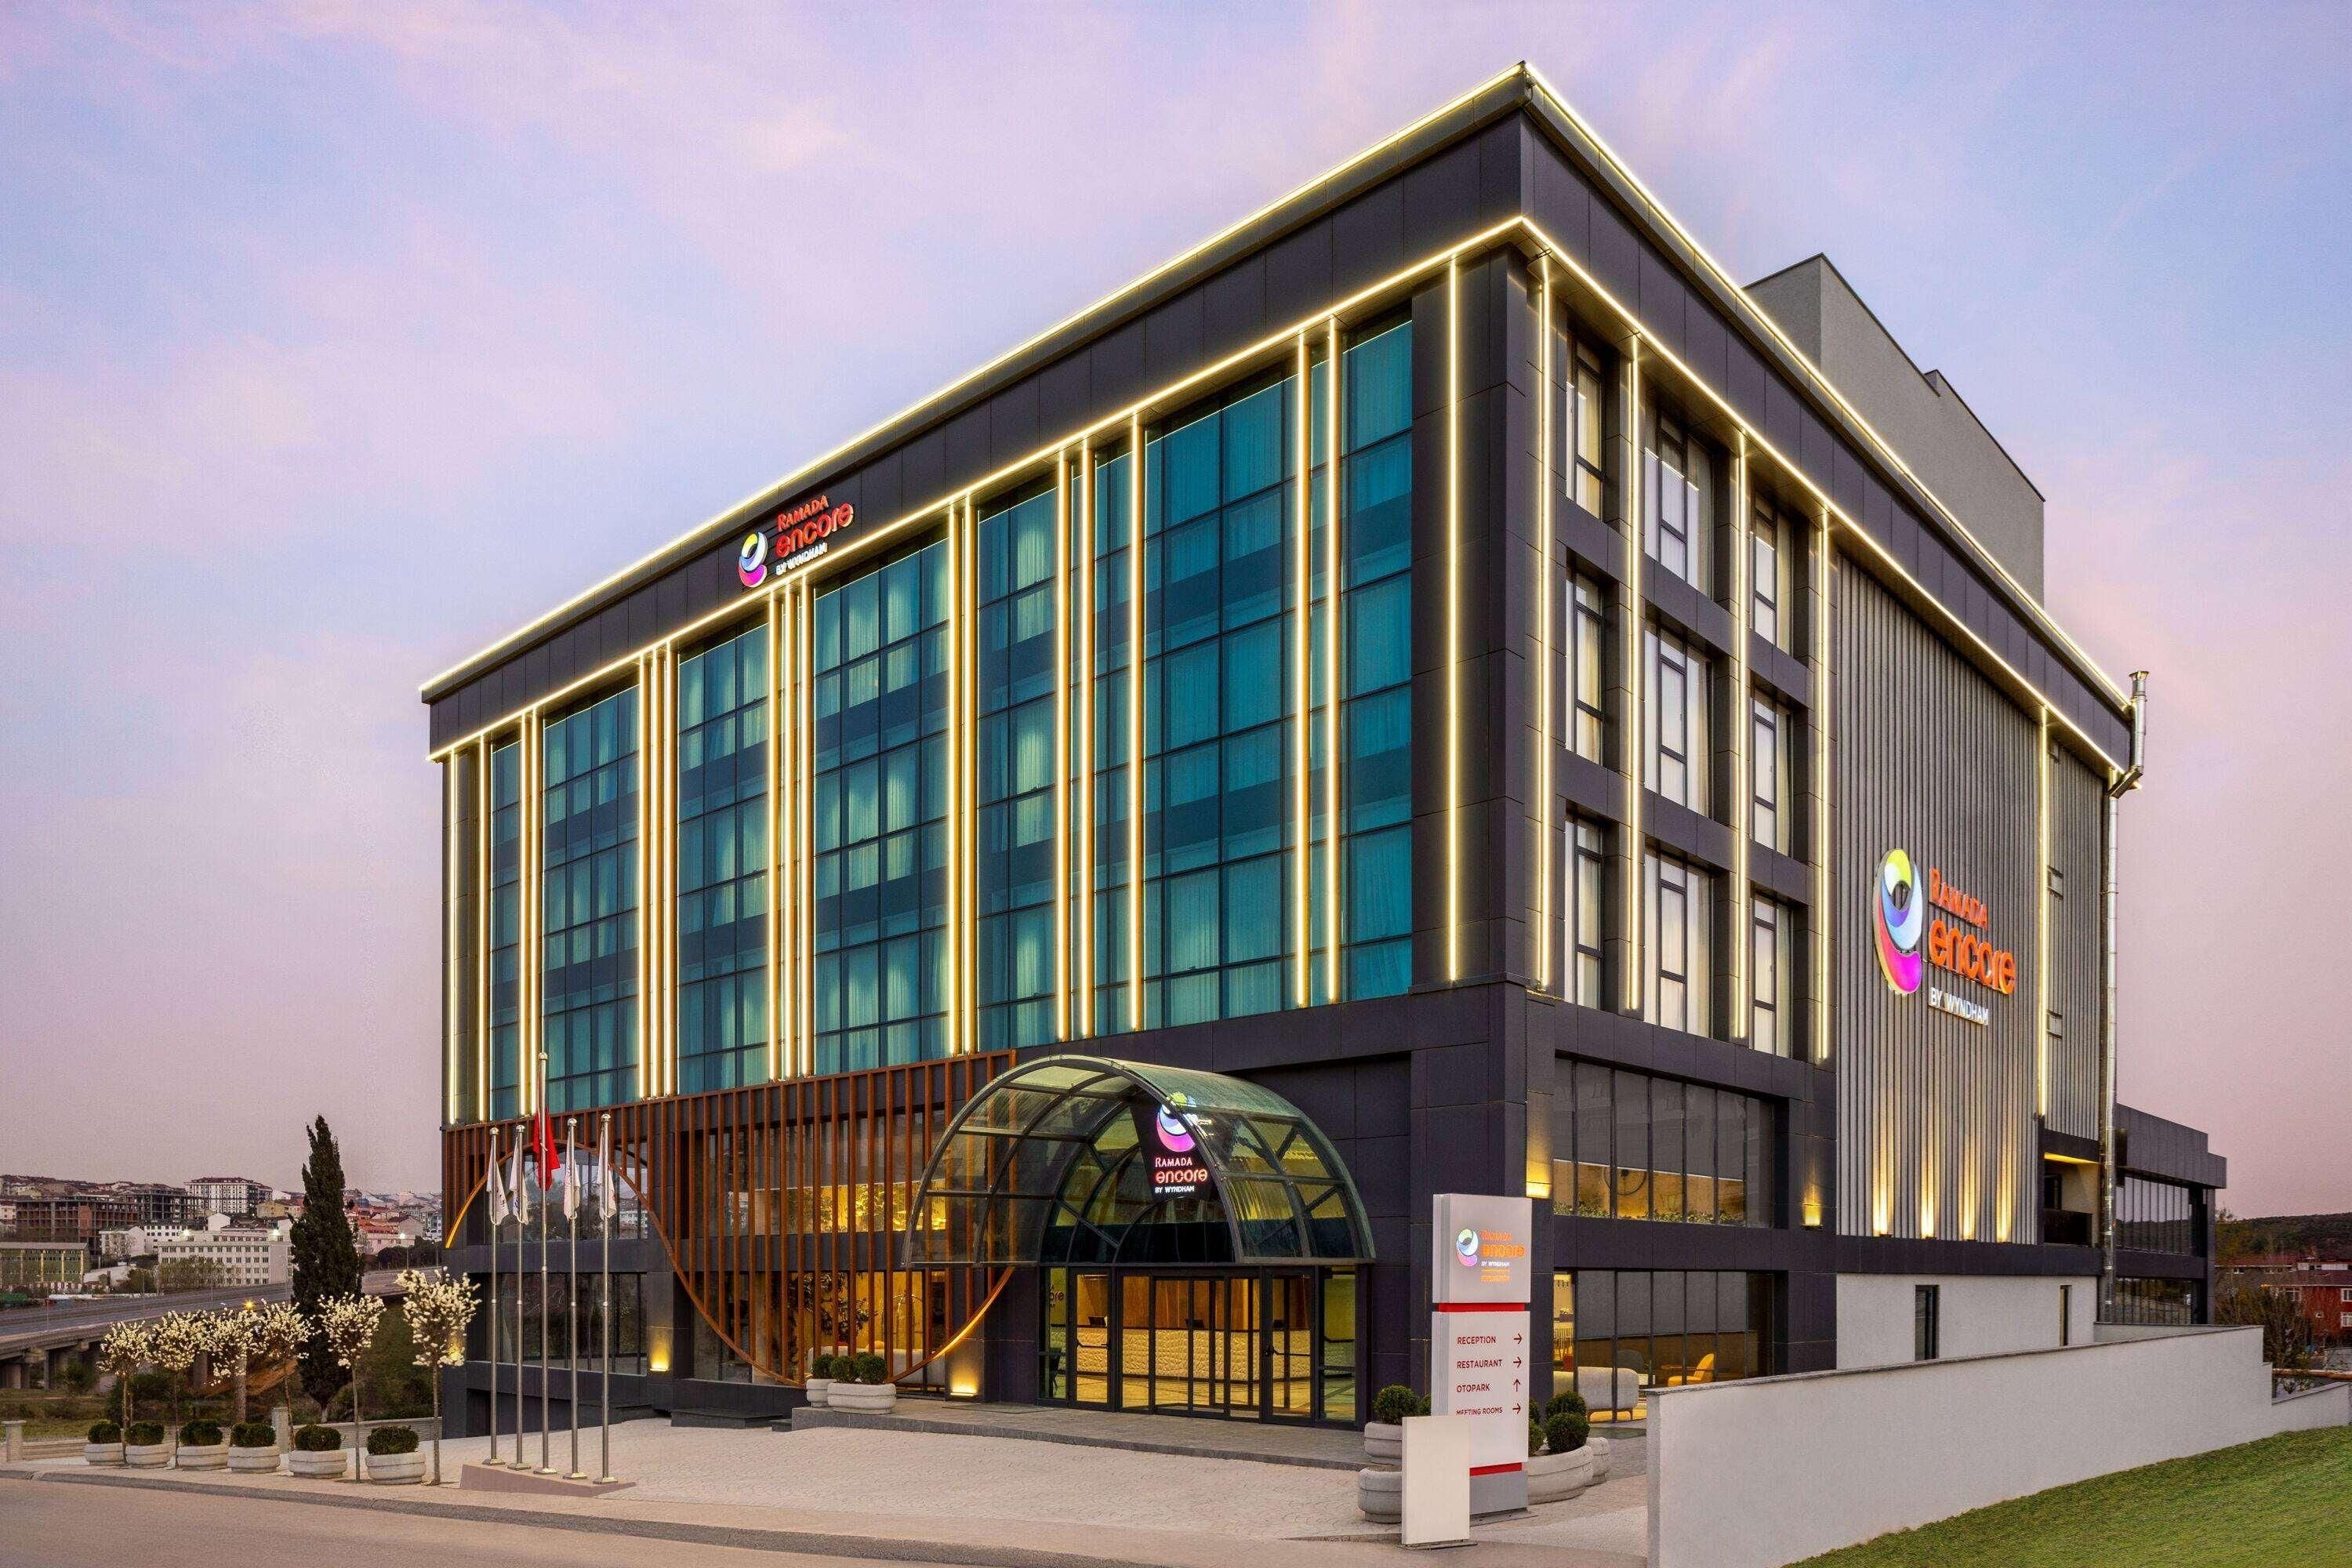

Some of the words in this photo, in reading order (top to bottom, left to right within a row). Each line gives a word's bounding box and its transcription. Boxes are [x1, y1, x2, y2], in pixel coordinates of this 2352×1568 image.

[777, 495, 829, 532] RAMADA
[775, 502, 854, 558] encore
[776, 562, 787, 575] BY
[787, 543, 828, 569] WYNDHAM
[1929, 866, 1989, 931] RAMADA
[1928, 919, 2016, 995] encore
[1931, 987, 1942, 1007] BY
[1944, 992, 1988, 1025] WYNDHAM
[1155, 1157, 1192, 1167] RAMADA
[1155, 1168, 1208, 1184] encore
[1481, 1243, 1525, 1258] encore
[1457, 1336, 1497, 1345] RECEPTION
[1457, 1359, 1503, 1369] RESTAURANT
[1456, 1383, 1490, 1392] OTOPARK
[1482, 1406, 1503, 1415] ROOMS
